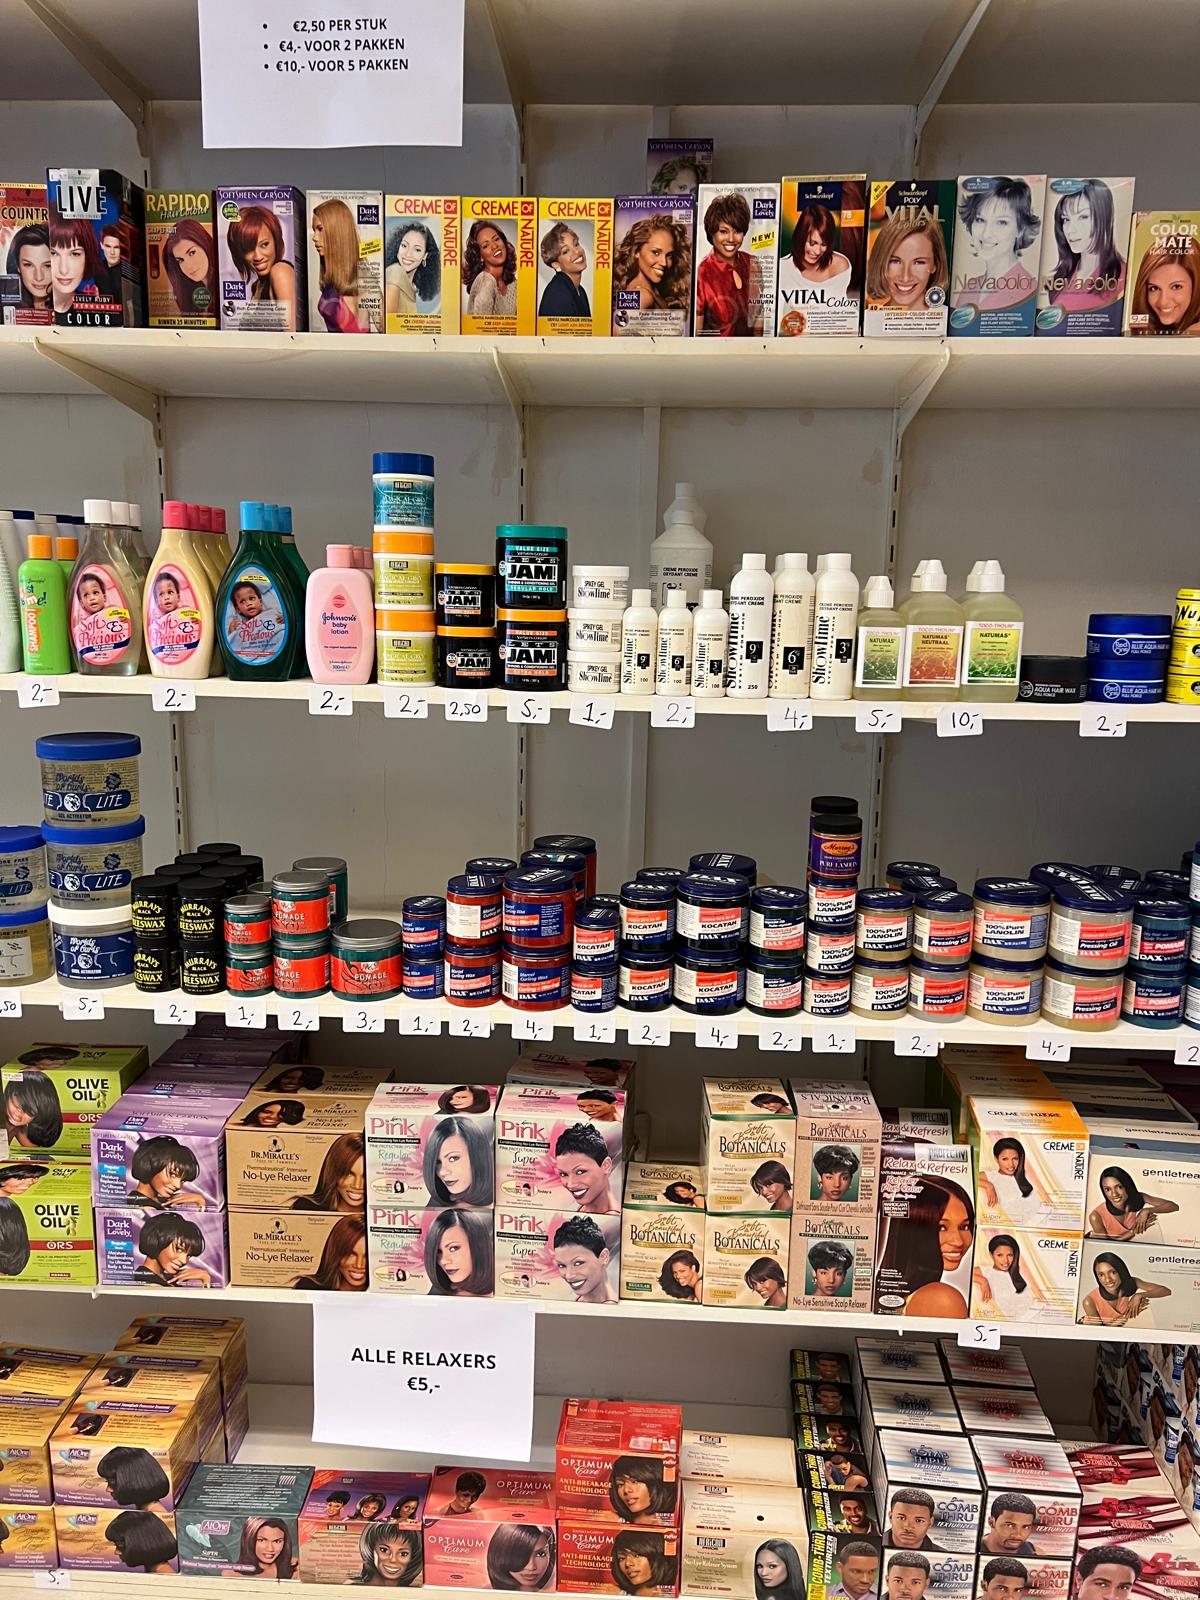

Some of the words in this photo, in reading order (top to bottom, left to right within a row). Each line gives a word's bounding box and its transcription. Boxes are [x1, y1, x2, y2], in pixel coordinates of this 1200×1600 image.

[293, 20, 325, 33] €2,50
[330, 20, 351, 31] PER
[355, 19, 387, 30] STUK
[279, 41, 301, 53] €4,-
[305, 40, 340, 51] VOOR
[344, 40, 351, 51] 2
[355, 39, 405, 50] PAKKEN
[276, 61, 305, 73] €10,-
[308, 60, 345, 71] VOOR
[348, 60, 355, 71] 5
[359, 59, 408, 70] PAKKEN
[57, 186, 107, 213] LIVE
[146, 193, 209, 212] RAPIDO
[395, 199, 441, 214] CREME
[445, 202, 456, 211] OF
[755, 201, 774, 209] Dark
[1, 207, 48, 220] COUNTR
[472, 201, 518, 216] CREME
[522, 205, 533, 213] OF
[548, 202, 595, 216] CREME
[598, 205, 610, 213] OF
[886, 205, 945, 223] VITAL
[752, 232, 774, 243] NEW!
[1151, 224, 1198, 236] COLOR
[444, 218, 457, 266] NATURE
[520, 219, 534, 268] NATURE
[596, 220, 611, 269] NATURE
[1155, 237, 1192, 248] MATE
[954, 274, 1037, 291] Nevacolor
[1041, 275, 1122, 292] Nevacolor
[619, 292, 638, 300] Dark
[782, 290, 826, 304] VITAL
[826, 297, 858, 307] Colors
[68, 313, 110, 325] COLOR
[322, 613, 357, 625] Johnson's
[29, 611, 37, 652] SHAMPOO
[79, 631, 124, 647] Precious
[153, 631, 193, 644] Precious
[31, 684, 52, 702] 2,-
[165, 689, 186, 707] 2,-
[320, 691, 344, 710] 2,-
[400, 695, 425, 714] 2,-
[450, 702, 480, 716] 2,50
[521, 699, 542, 719] 5,-
[667, 703, 692, 723] 2,-
[785, 708, 808, 728] 4,-
[868, 710, 893, 728] 5,-
[952, 712, 979, 729] 10,-
[1097, 716, 1122, 735] 2,-
[96, 794, 123, 809] LITE
[95, 873, 122, 888] LITE
[817, 904, 852, 912] LANOLIN
[275, 912, 304, 920] POMADE
[180, 922, 214, 930] BEESWAX
[1155, 941, 1184, 949] POMADE
[184, 975, 219, 984] BEESWAX
[355, 972, 387, 981] POMADE
[79, 997, 98, 1013] 5,-
[170, 1005, 187, 1021] 2,-
[293, 1011, 312, 1028] 2,-
[357, 1012, 376, 1030] 3,-
[462, 1020, 478, 1036] 2,-
[526, 1022, 543, 1039] 4,-
[642, 1025, 661, 1044] 2,-
[711, 1028, 729, 1046] 4,-
[772, 1032, 793, 1049] 2,-
[911, 1037, 930, 1053] 2,-
[66, 1079, 109, 1089] OLIVE
[72, 1091, 96, 1101] OIL
[370, 1118, 416, 1135] Pink
[501, 1120, 544, 1140] Pink
[811, 1122, 867, 1138] BOTANICALS
[101, 1142, 123, 1152] Dark
[719, 1136, 786, 1153] BOTANICALS
[1044, 1142, 1074, 1150] CREME
[379, 1149, 409, 1162] Regular
[512, 1151, 538, 1165] Super
[883, 1158, 916, 1170] Relax
[917, 1160, 927, 1169] &
[927, 1162, 968, 1175] Refresh
[1075, 1152, 1083, 1180] NATURE
[243, 1171, 275, 1181] No-Lye
[277, 1172, 312, 1183] Relaxer
[35, 1205, 79, 1216] OLIVE
[372, 1208, 416, 1226] Pink
[41, 1217, 66, 1228] OIL
[107, 1219, 129, 1229] Dark
[500, 1214, 544, 1232] Pink
[805, 1219, 860, 1235] BOTANICALS
[107, 1229, 132, 1238] Lovely
[630, 1225, 695, 1244] BOTANICALS
[714, 1232, 780, 1250] BOTANICALS
[47, 1241, 73, 1249] ORS
[511, 1243, 536, 1258] Super
[1038, 1240, 1068, 1248] CREME
[246, 1252, 278, 1262] No-Lye
[280, 1253, 314, 1263] Relaxer
[1067, 1251, 1076, 1276] NATURE
[352, 1348, 395, 1364] ALLE
[403, 1351, 496, 1369] RELAXERS
[407, 1377, 440, 1393] €5,-
[561, 1458, 612, 1470] OPTIMUM
[497, 1480, 551, 1490] OPTIMUM
[560, 1478, 613, 1488] ANTI-BREAKAGE
[564, 1485, 608, 1494] TECHNOLOGY
[937, 1502, 979, 1513] COMB
[1037, 1506, 1078, 1517] COMB
[939, 1512, 974, 1522] THRU
[1040, 1516, 1073, 1526] THRU
[428, 1536, 484, 1548] OPTIMUM
[563, 1533, 614, 1544] OPTIMUM
[561, 1553, 613, 1563] ANTI-BREAKAGE
[566, 1559, 610, 1568] TECHNOLOGY
[811, 1533, 826, 1584] COMB-THRU
[824, 1535, 834, 1583] TEXTURIZER
[933, 1563, 973, 1573] COMB
[935, 1572, 969, 1581] THRU
